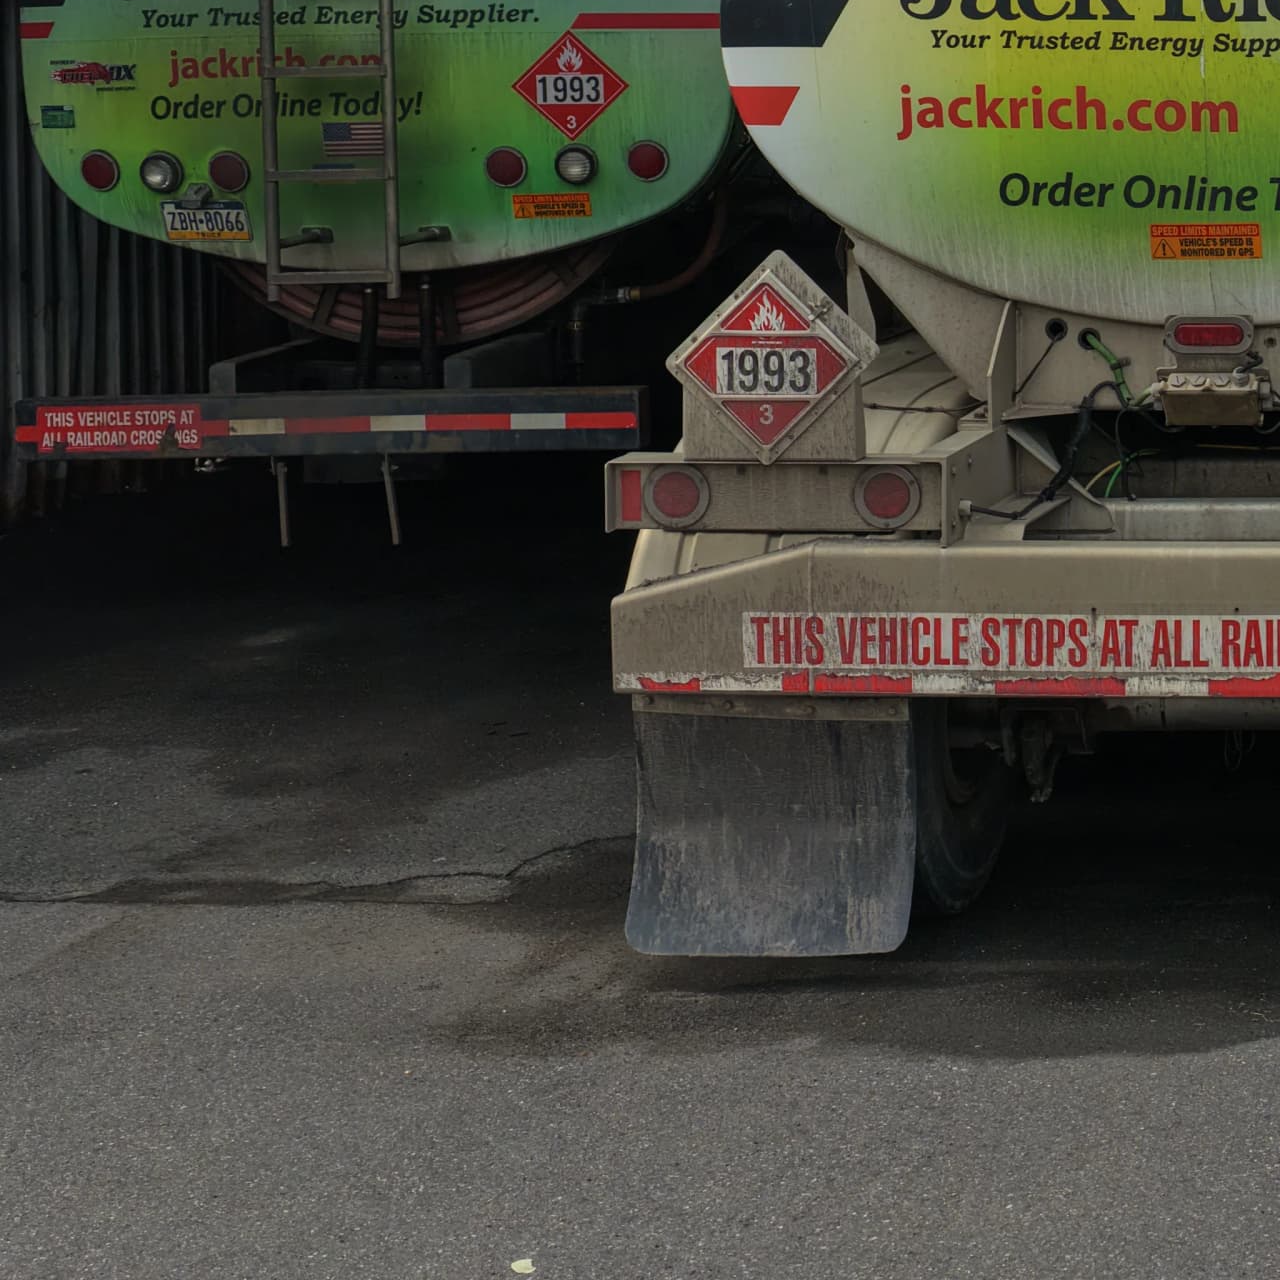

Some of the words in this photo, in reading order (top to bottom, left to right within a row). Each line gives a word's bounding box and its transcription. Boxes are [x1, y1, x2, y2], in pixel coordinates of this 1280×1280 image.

[142, 8, 198, 28] Your
[208, 6, 306, 26] Trused
[417, 3, 539, 28] Supplier.
[930, 29, 990, 50] Your
[1000, 29, 1101, 51] Trusted
[1109, 31, 1205, 57] Energy
[537, 76, 600, 103] 1993
[151, 93, 226, 119] Order
[329, 91, 423, 121] Tody!
[897, 84, 1239, 140] jackrich.com
[566, 116, 577, 129] 3
[999, 172, 1114, 207] Order
[1123, 175, 1258, 212] Online
[1151, 227, 1178, 236] SPEED
[1180, 226, 1207, 236] LIMITS
[1208, 225, 1258, 235] MAINTAINED
[1180, 238, 1217, 247] VEHICLE'S
[1220, 238, 1243, 246] SPEED
[1246, 238, 1253, 246] IS
[1180, 248, 1225, 256] MONITORED
[1227, 248, 1238, 256] BY
[1239, 248, 1254, 256] GPS
[721, 350, 811, 392] 1993
[45, 412, 74, 427] THIS
[77, 411, 132, 426] VEHICLE
[134, 409, 177, 425] STOPS
[180, 409, 195, 424] AT
[759, 404, 774, 425] 3
[67, 430, 127, 447] RAILROAD
[750, 617, 823, 665] THIS
[836, 617, 969, 665] VEHICLE
[981, 617, 1088, 667] STOPS
[1101, 619, 1139, 667] AT
[1151, 619, 1209, 667] ALL
